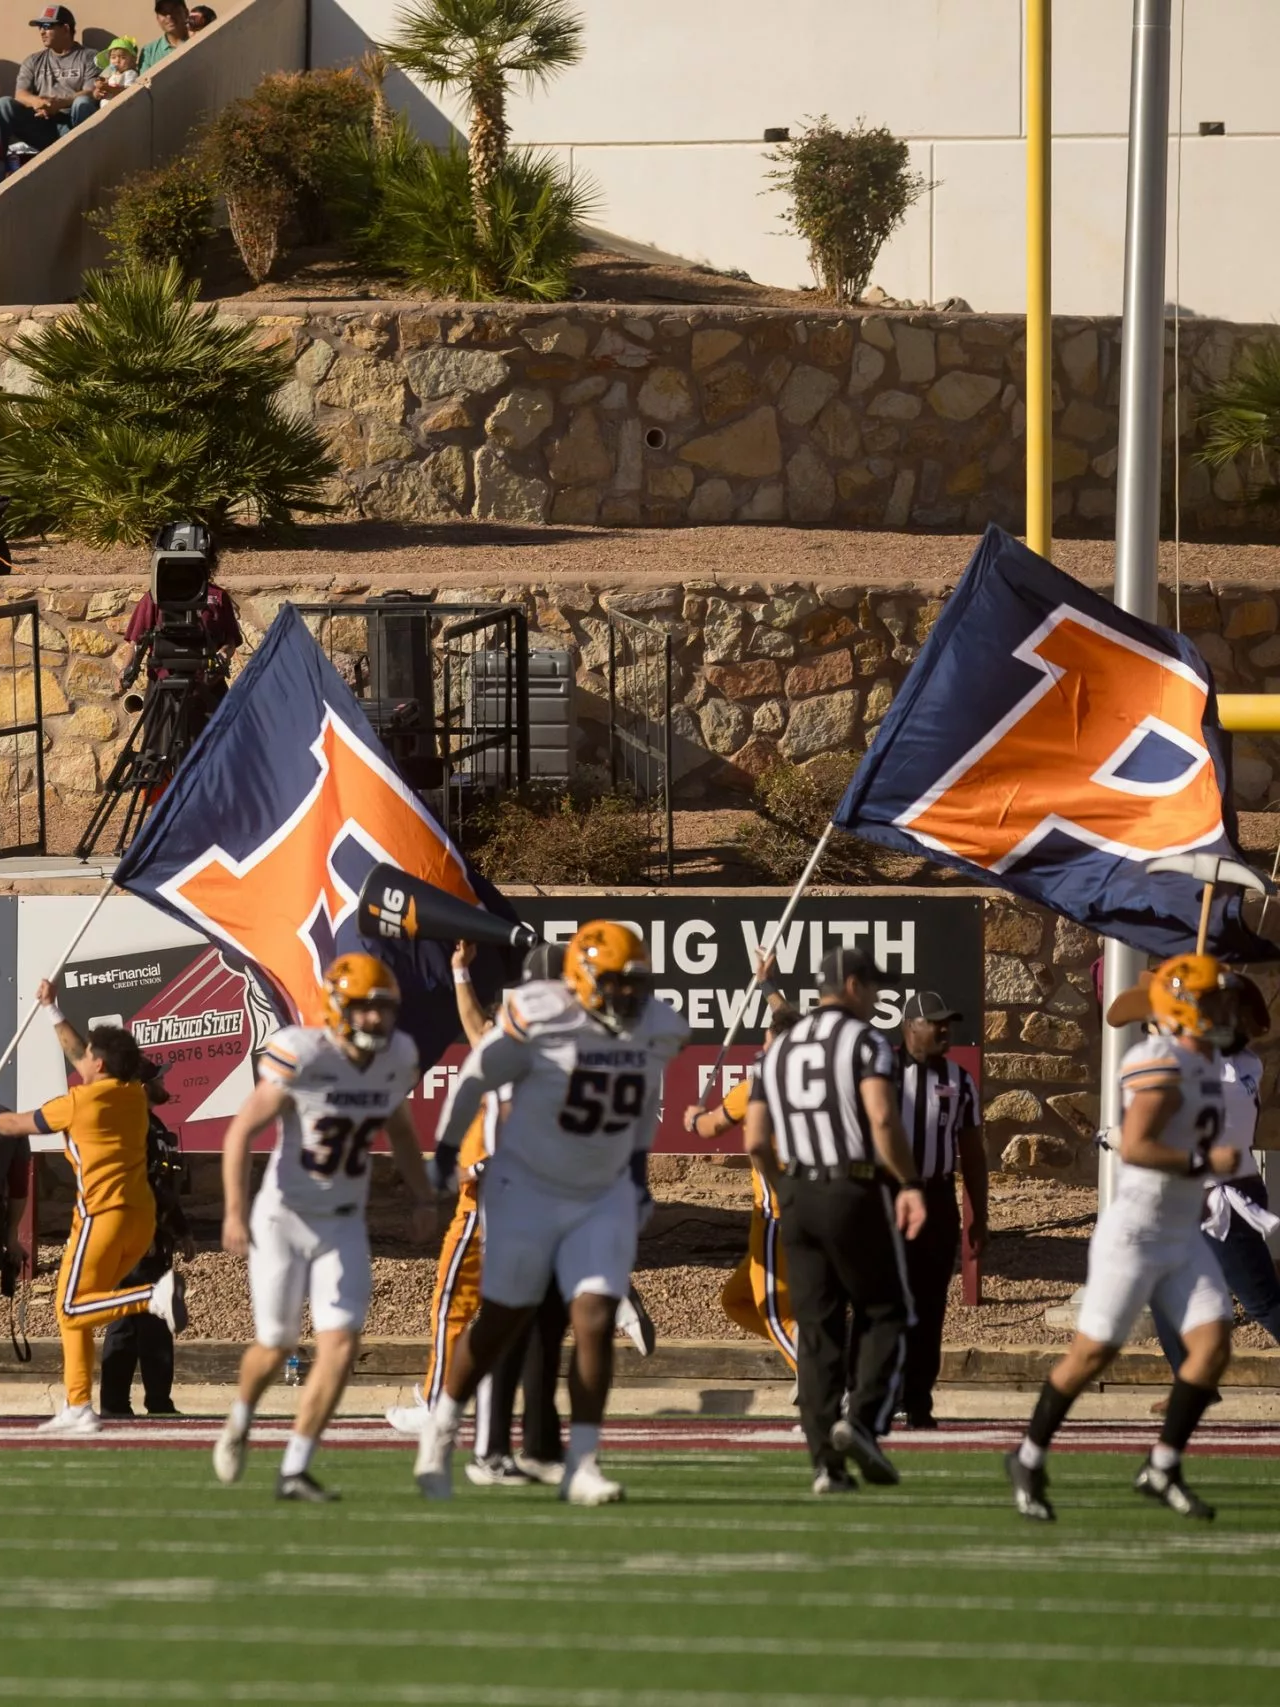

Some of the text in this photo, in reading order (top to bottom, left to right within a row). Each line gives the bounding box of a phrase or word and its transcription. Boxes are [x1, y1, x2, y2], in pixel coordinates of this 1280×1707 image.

[604, 919, 718, 975] IG
[740, 919, 916, 975] WITH
[79, 962, 162, 987] FirstFinancial
[112, 976, 163, 990] CREDIT UNION
[135, 1011, 241, 1045] NEW MEXICO STATE
[169, 1046, 203, 1065] 9876
[207, 1040, 243, 1058] 5432
[183, 1076, 210, 1088] 07/23
[785, 1042, 827, 1110] C
[557, 1068, 647, 1138] 59
